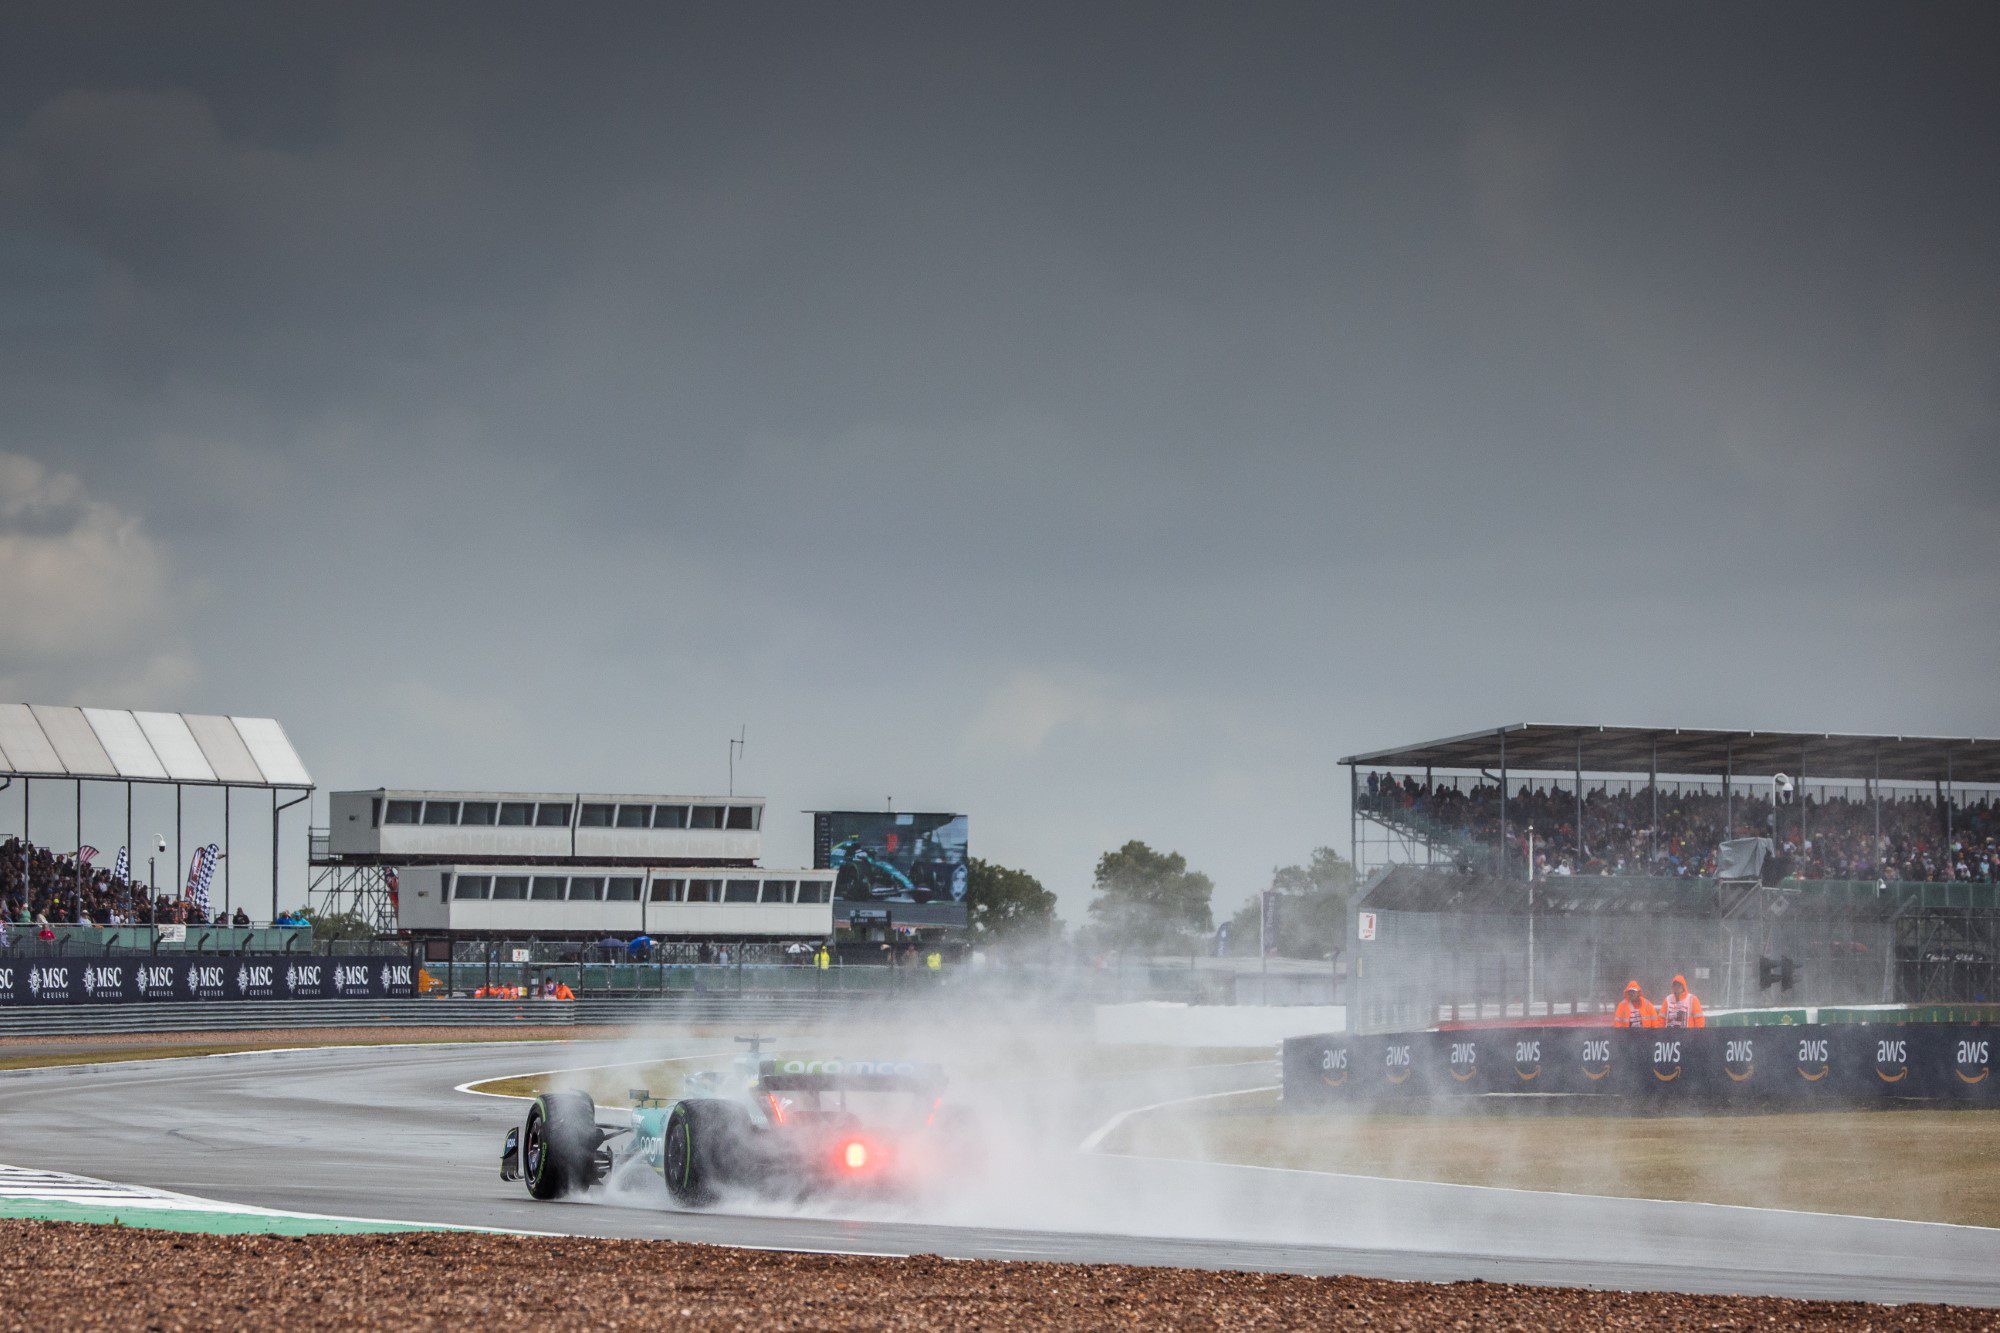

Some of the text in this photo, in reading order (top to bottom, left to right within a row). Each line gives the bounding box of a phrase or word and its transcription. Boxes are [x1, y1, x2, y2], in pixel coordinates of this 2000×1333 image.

[0, 968, 13, 989] SC
[41, 968, 69, 988] MSC
[96, 967, 122, 987] MSC
[149, 967, 174, 986] MSC
[200, 967, 224, 986] MSC
[249, 966, 273, 985] MSC
[298, 966, 321, 985] MSC
[345, 966, 369, 985] MSC
[392, 965, 412, 985] MSC
[42, 991, 69, 999] CRUISES
[1323, 1049, 1347, 1069] aws
[1386, 1046, 1410, 1066] aws
[1451, 1043, 1476, 1064] aws
[1515, 1041, 1541, 1062] aws
[1583, 1040, 1610, 1061] aws
[1654, 1041, 1681, 1063] aws
[1726, 1040, 1753, 1062] aws
[1799, 1039, 1828, 1062] aws
[1877, 1040, 1907, 1063] aws
[1957, 1040, 1989, 1064] aws
[783, 1060, 914, 1076] aramco
